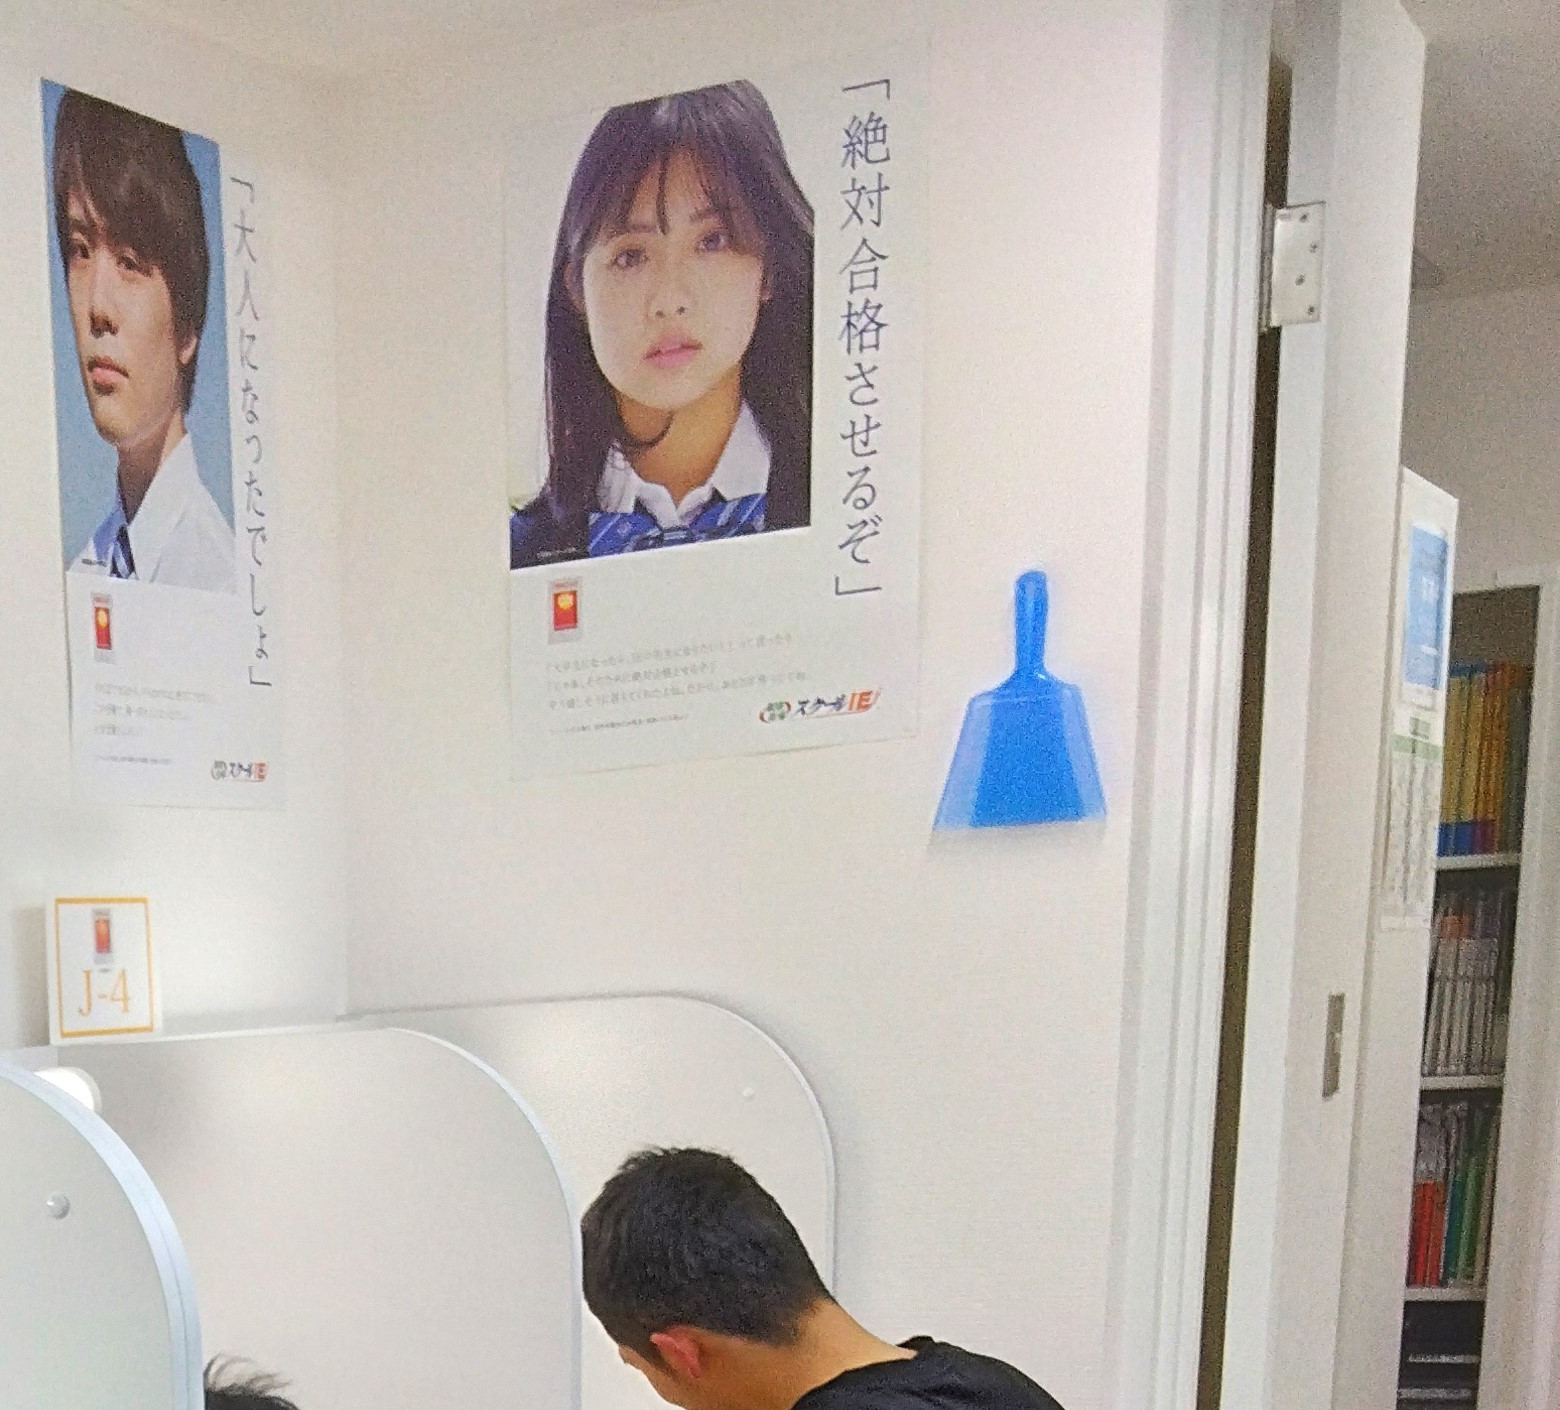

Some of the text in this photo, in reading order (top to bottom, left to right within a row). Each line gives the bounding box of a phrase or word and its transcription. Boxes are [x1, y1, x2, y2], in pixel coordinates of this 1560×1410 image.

[230, 176, 272, 687] 「大人になったでしょ」
[835, 79, 891, 596] 「絶対合格させるぞ」
[77, 968, 131, 1017] J-4
